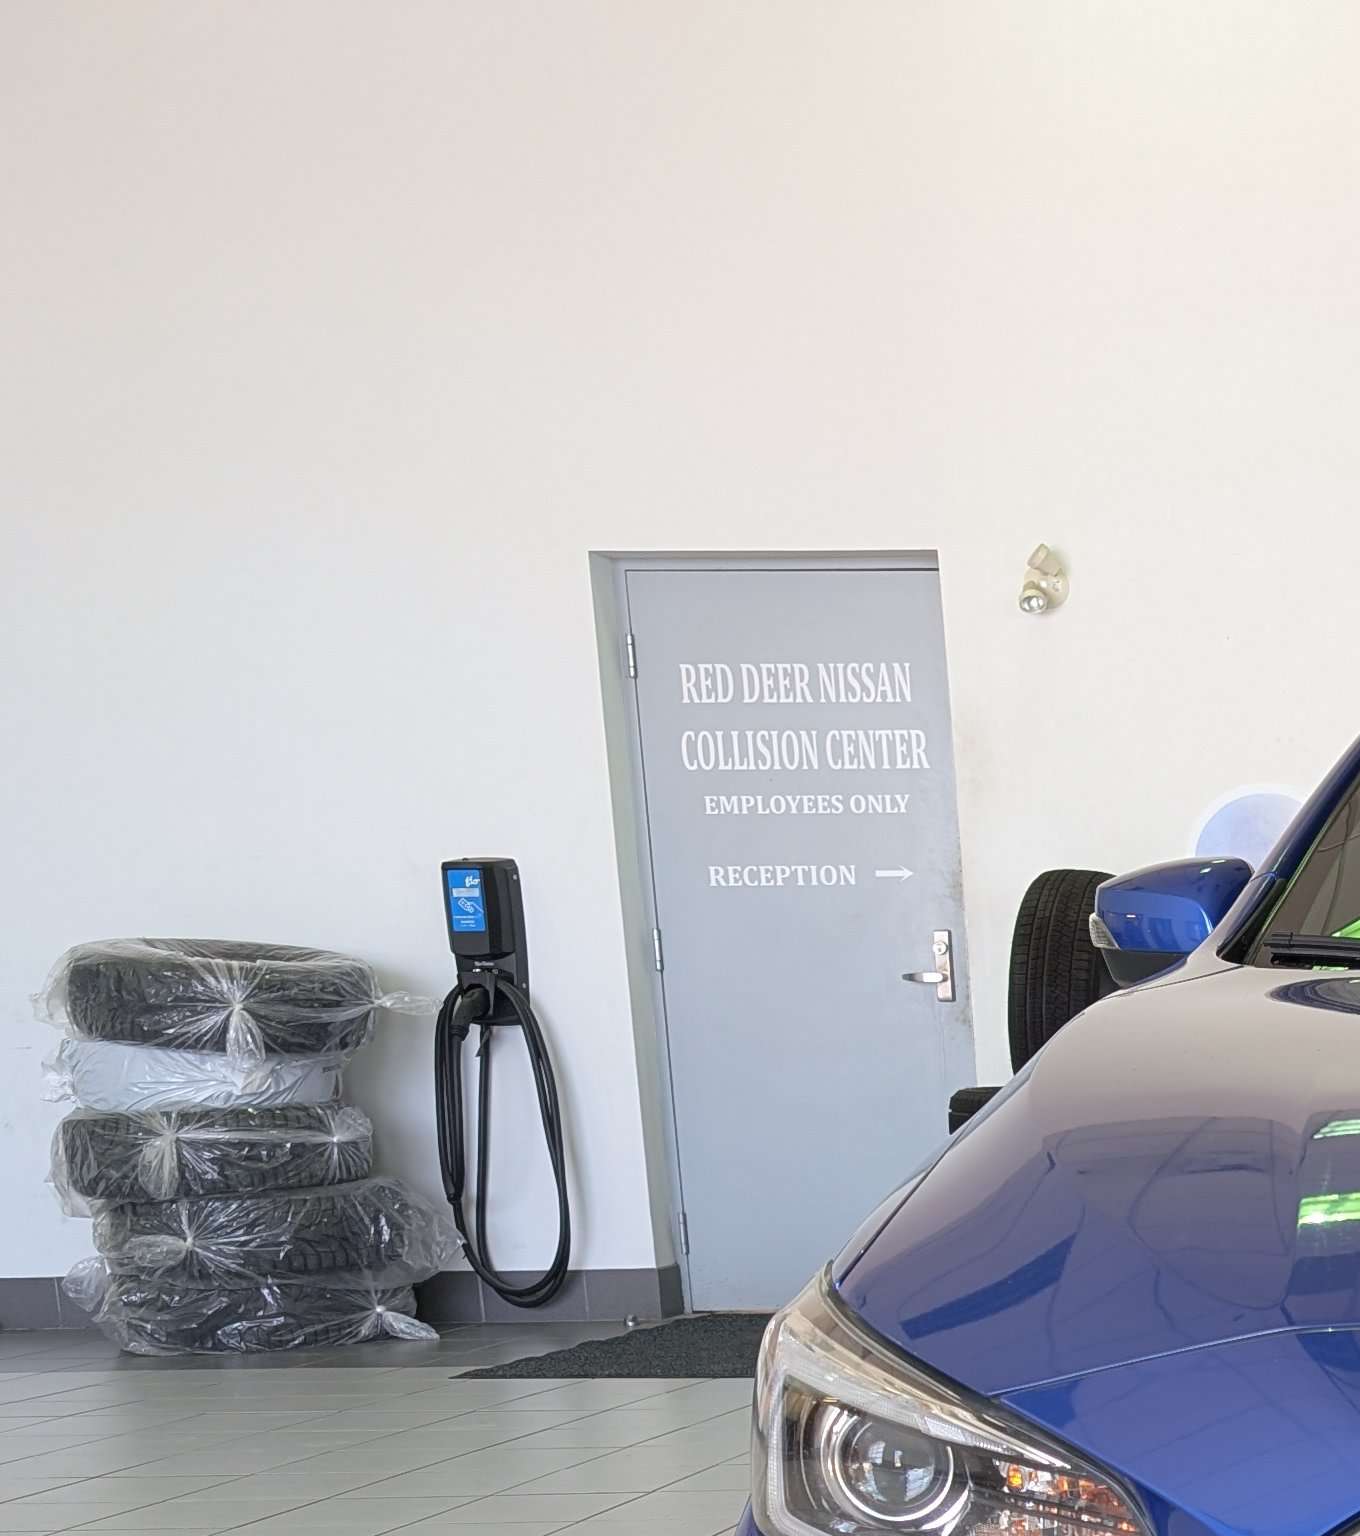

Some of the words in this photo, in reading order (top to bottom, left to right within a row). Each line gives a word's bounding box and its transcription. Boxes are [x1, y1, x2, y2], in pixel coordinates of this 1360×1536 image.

[679, 663, 734, 703] RED
[740, 663, 813, 703] DEER
[817, 662, 912, 703] NISSAN
[681, 730, 818, 771] COLLISION
[826, 729, 930, 770] CENTER
[704, 795, 844, 815] EMPLOYEES
[850, 794, 910, 814] ONLY
[708, 865, 856, 887] RECEPTION
